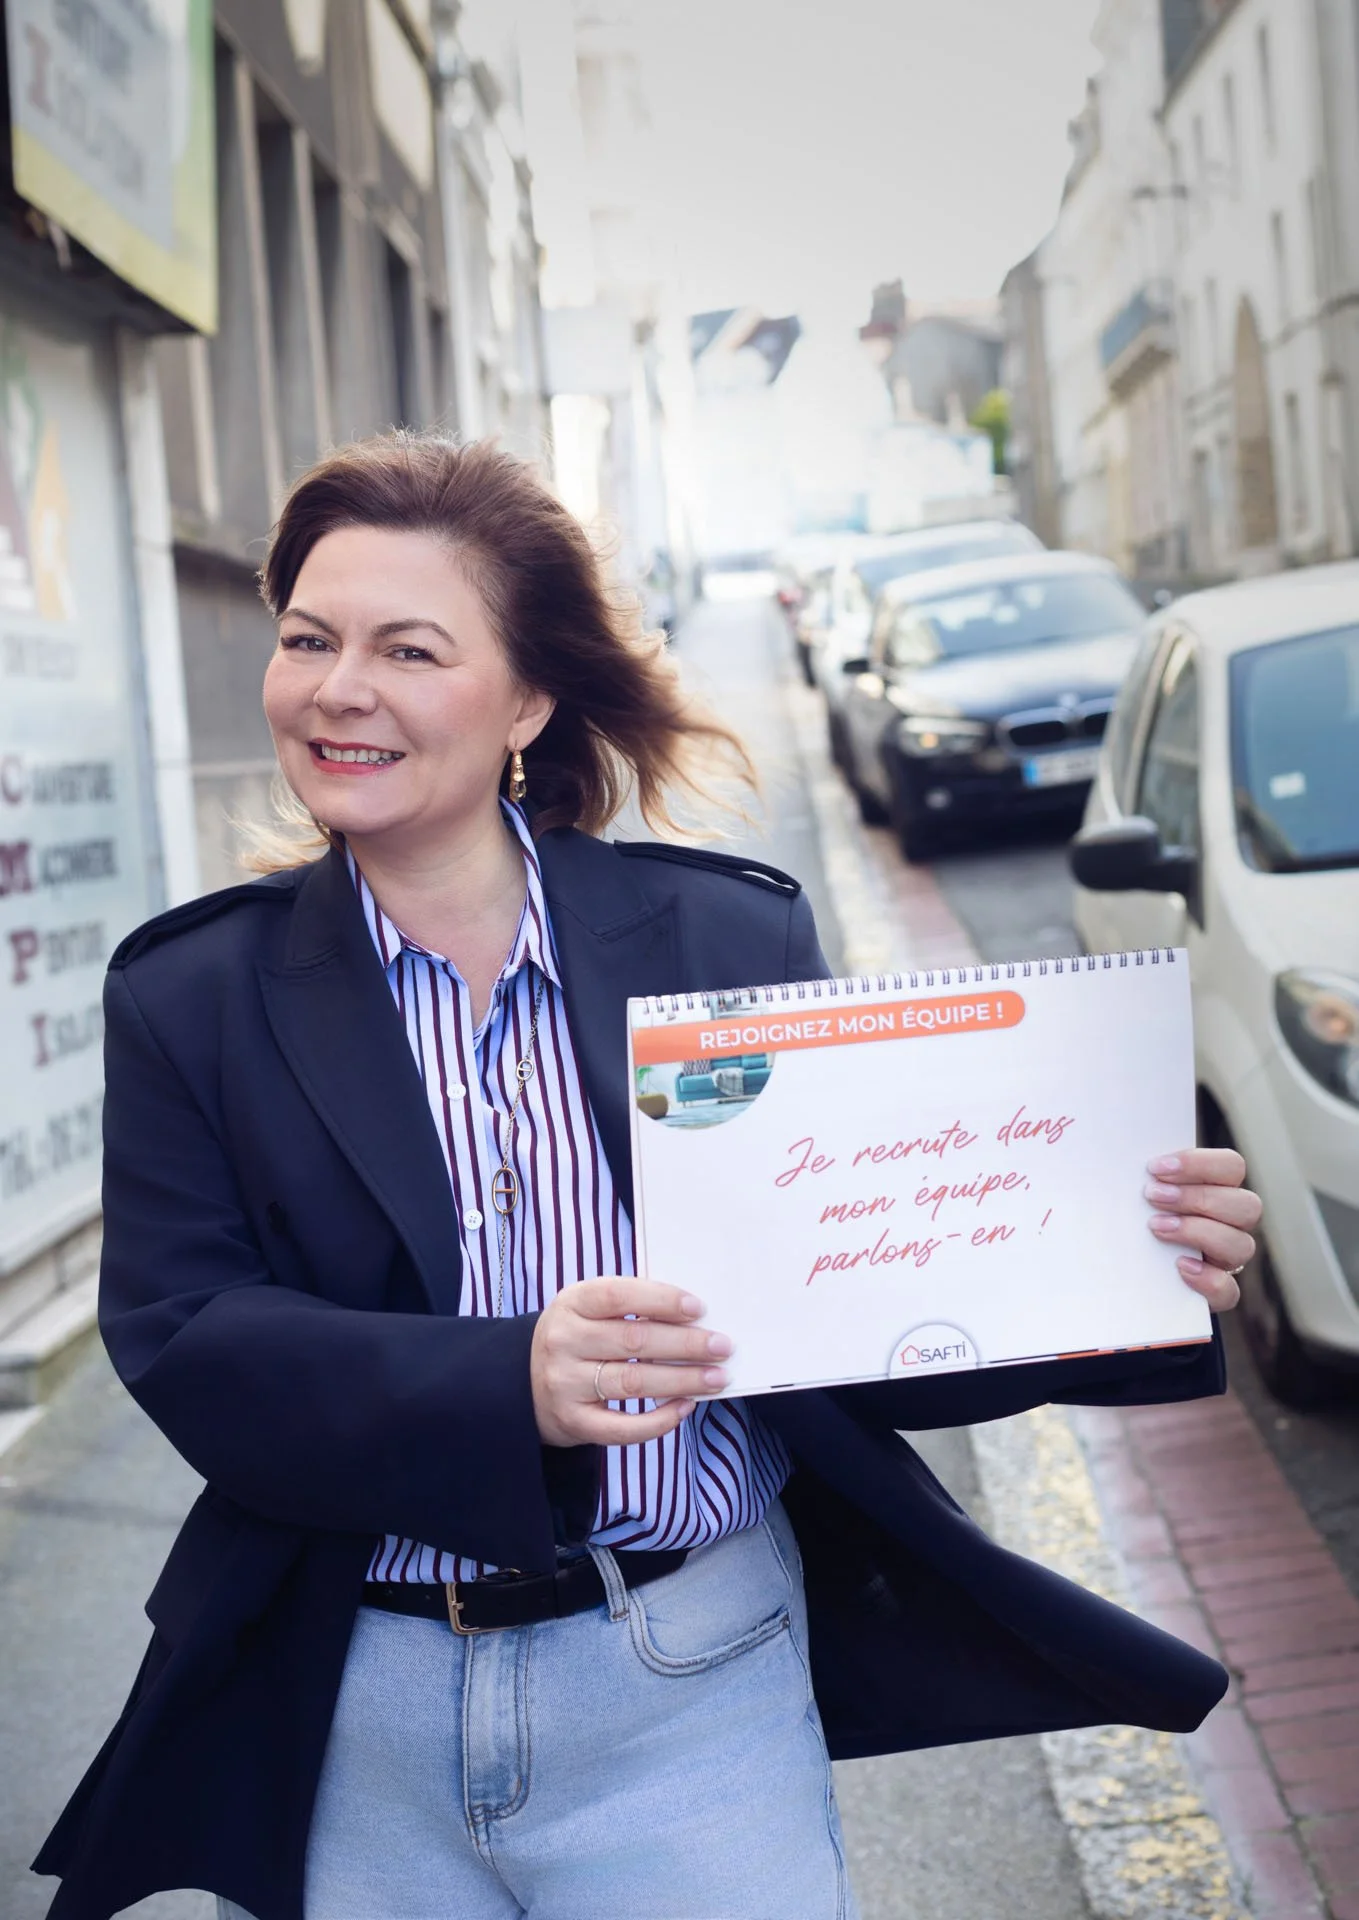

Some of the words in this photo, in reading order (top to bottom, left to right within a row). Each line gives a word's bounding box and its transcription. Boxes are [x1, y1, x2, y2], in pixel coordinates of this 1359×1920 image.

[700, 1020, 832, 1050] REJOIGNEZ
[838, 1012, 895, 1035] MON
[902, 1003, 991, 1029] ÉQUIPE
[996, 1001, 1003, 1019] !
[775, 1137, 835, 1187] Je
[853, 1120, 978, 1167] recrute
[997, 1105, 1075, 1146] dans
[819, 1195, 896, 1224] mon
[806, 1224, 1015, 1286] parlons-en
[1038, 1208, 1052, 1235] !
